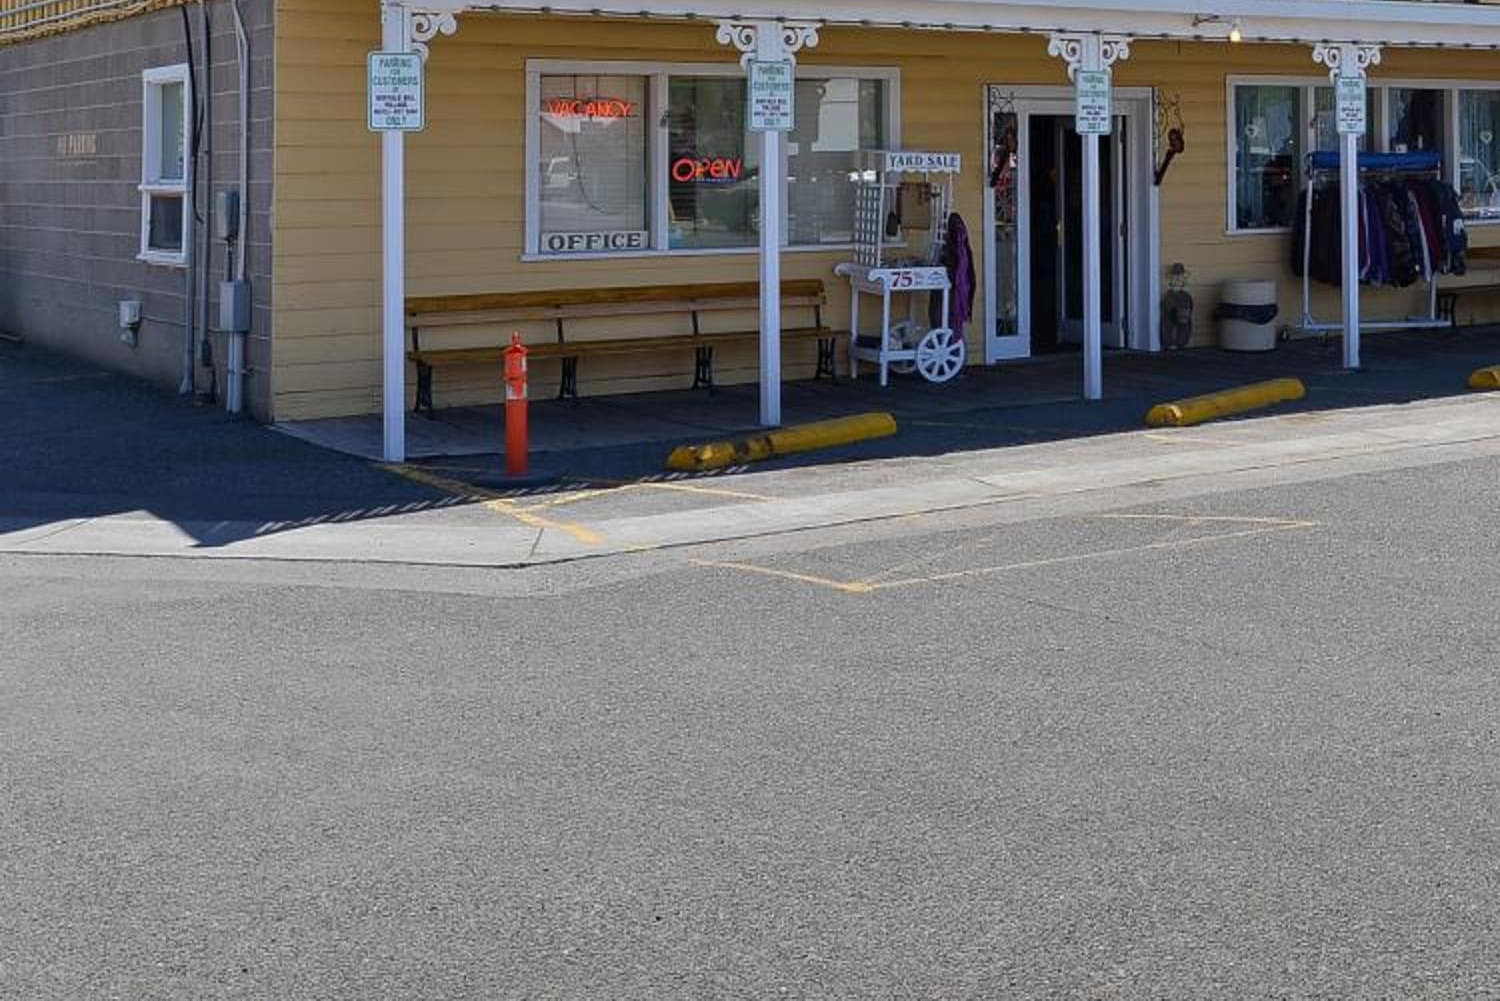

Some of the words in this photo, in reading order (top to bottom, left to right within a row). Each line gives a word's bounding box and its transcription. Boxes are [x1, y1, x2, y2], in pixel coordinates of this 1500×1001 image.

[549, 99, 631, 118] VACANCY
[889, 154, 923, 167] YARD
[927, 155, 958, 165] SALE
[547, 232, 642, 250] OFFICE
[890, 270, 913, 288] 75
